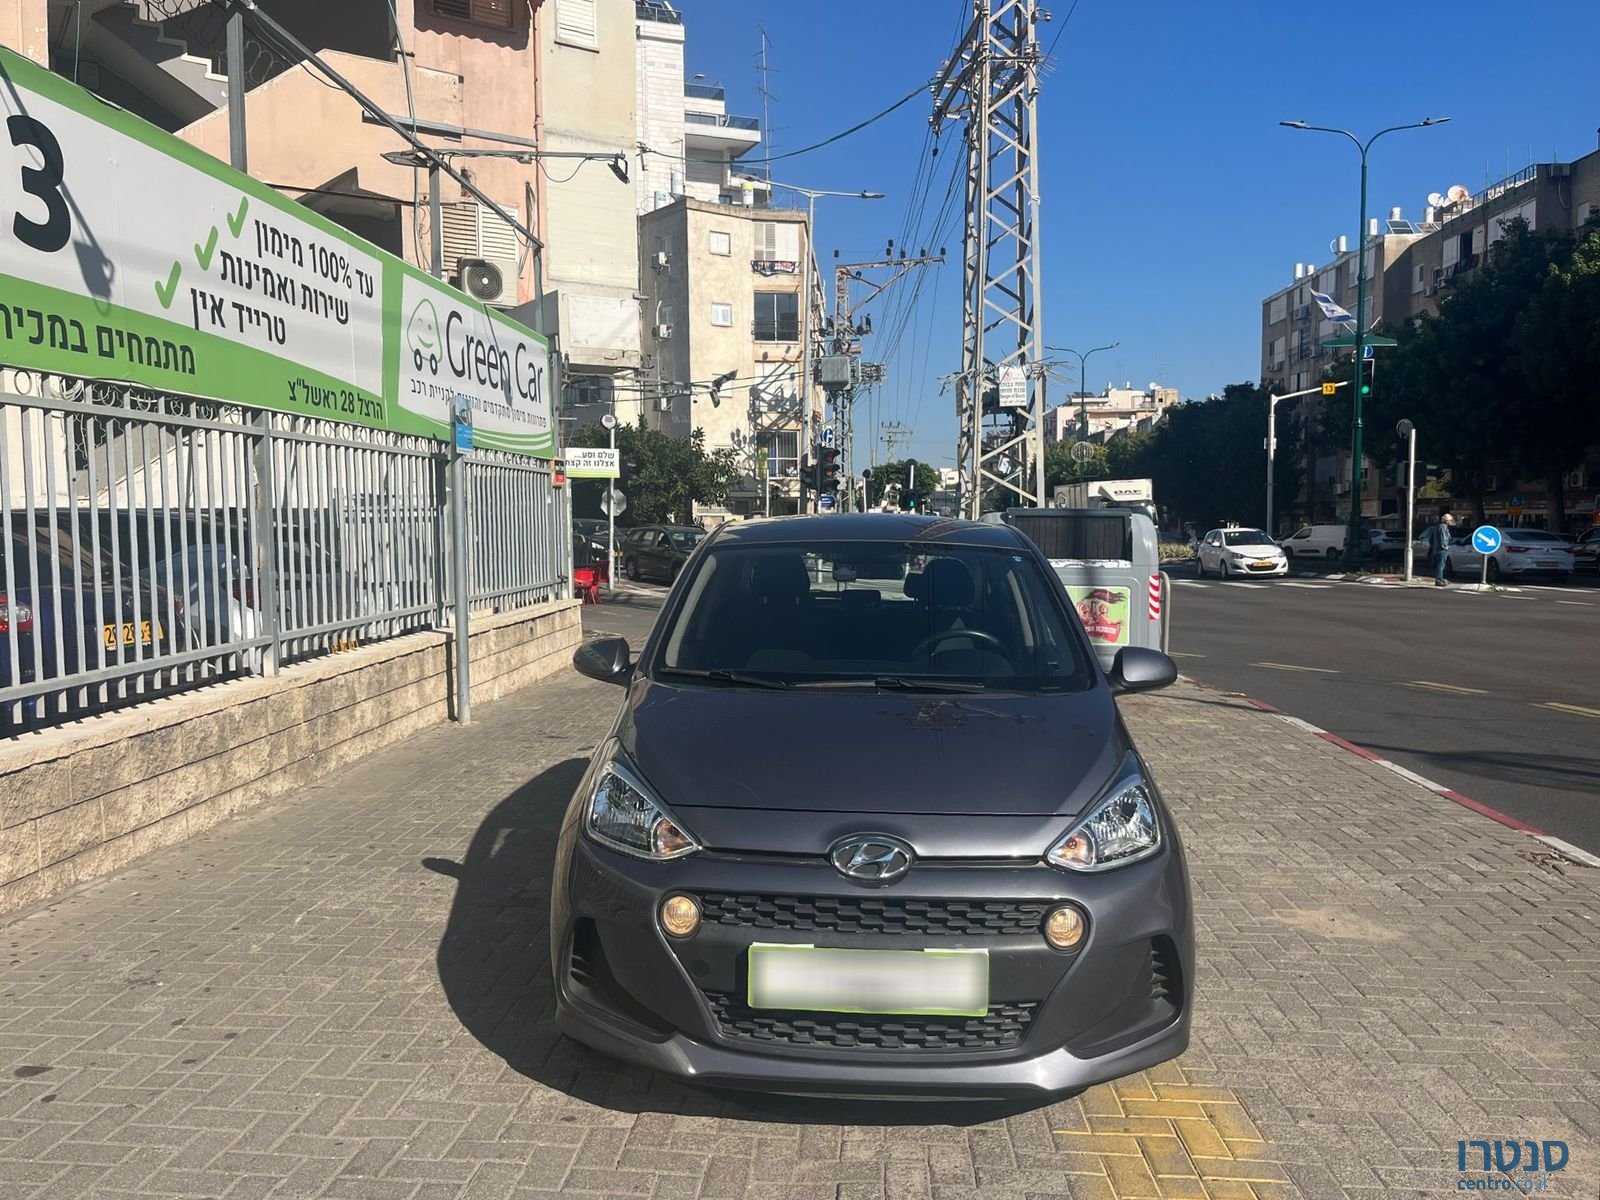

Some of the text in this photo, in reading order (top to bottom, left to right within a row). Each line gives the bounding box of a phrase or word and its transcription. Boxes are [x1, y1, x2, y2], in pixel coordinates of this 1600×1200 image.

[7, 115, 71, 252] 3
[254, 219, 374, 299] עד 100% מימון
[220, 250, 349, 325] שירות ואמינות
[191, 288, 286, 345] טרייד אין
[96, 325, 196, 375] מתמחים
[446, 310, 544, 404] Green Car
[340, 389, 355, 414] 28
[357, 393, 383, 420] הרצל
[410, 378, 427, 397] רכב
[1324, 384, 1334, 392] 13
[594, 459, 615, 468] אצלנו
[597, 451, 615, 459] שלם
